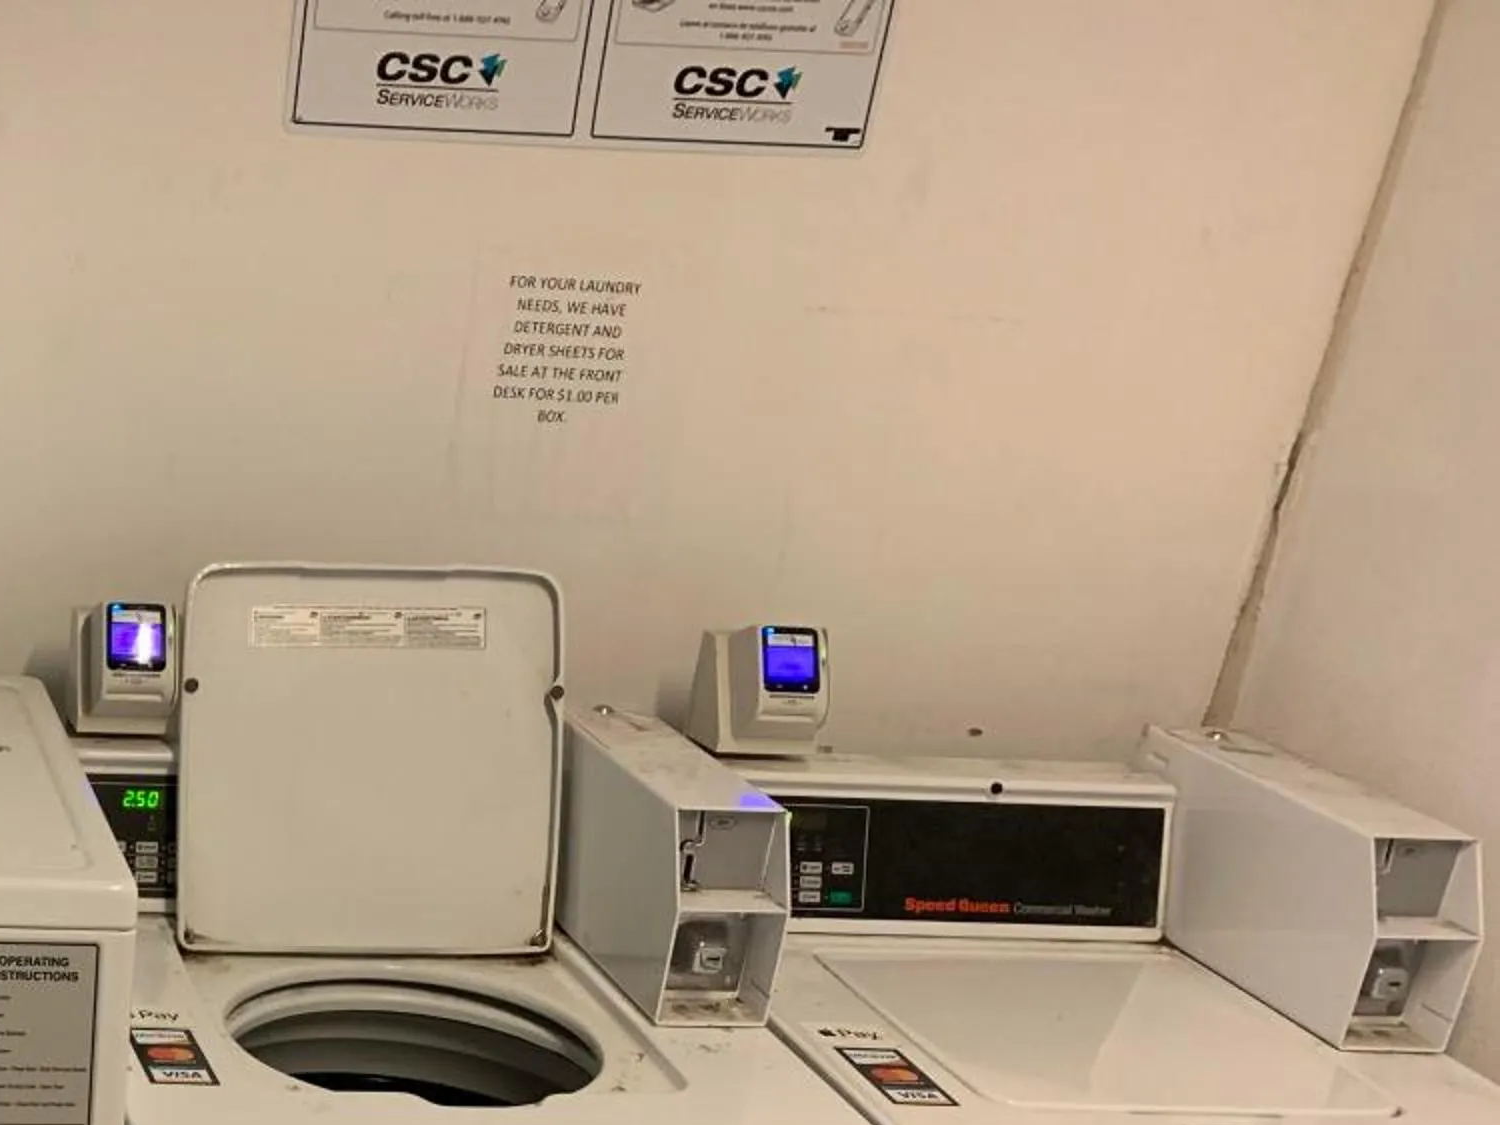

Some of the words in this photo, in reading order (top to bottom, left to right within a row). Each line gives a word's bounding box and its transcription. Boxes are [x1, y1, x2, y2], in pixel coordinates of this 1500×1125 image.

[376, 51, 473, 85] CSC
[673, 65, 769, 98] CSC
[509, 275, 537, 289] FOR
[540, 277, 577, 290] YOUR
[579, 279, 642, 295] LAUNDRY
[567, 301, 588, 315] WE
[591, 303, 627, 317] HAVE
[513, 320, 590, 337] DETERGENT
[592, 324, 622, 338] AND
[503, 342, 545, 357] DRYER
[548, 344, 596, 359] SHEETS
[598, 347, 625, 361] FOR
[497, 363, 528, 378] SALE
[531, 365, 548, 379] AT
[552, 367, 576, 380] THE
[579, 368, 622, 382] FRONT
[493, 385, 526, 399] DESK
[529, 387, 554, 401] FOR
[556, 388, 592, 403] $1.00
[595, 391, 619, 405] PER
[904, 897, 956, 914] Speed
[958, 898, 1009, 914] Queen
[162, 1071, 202, 1079] VISA
